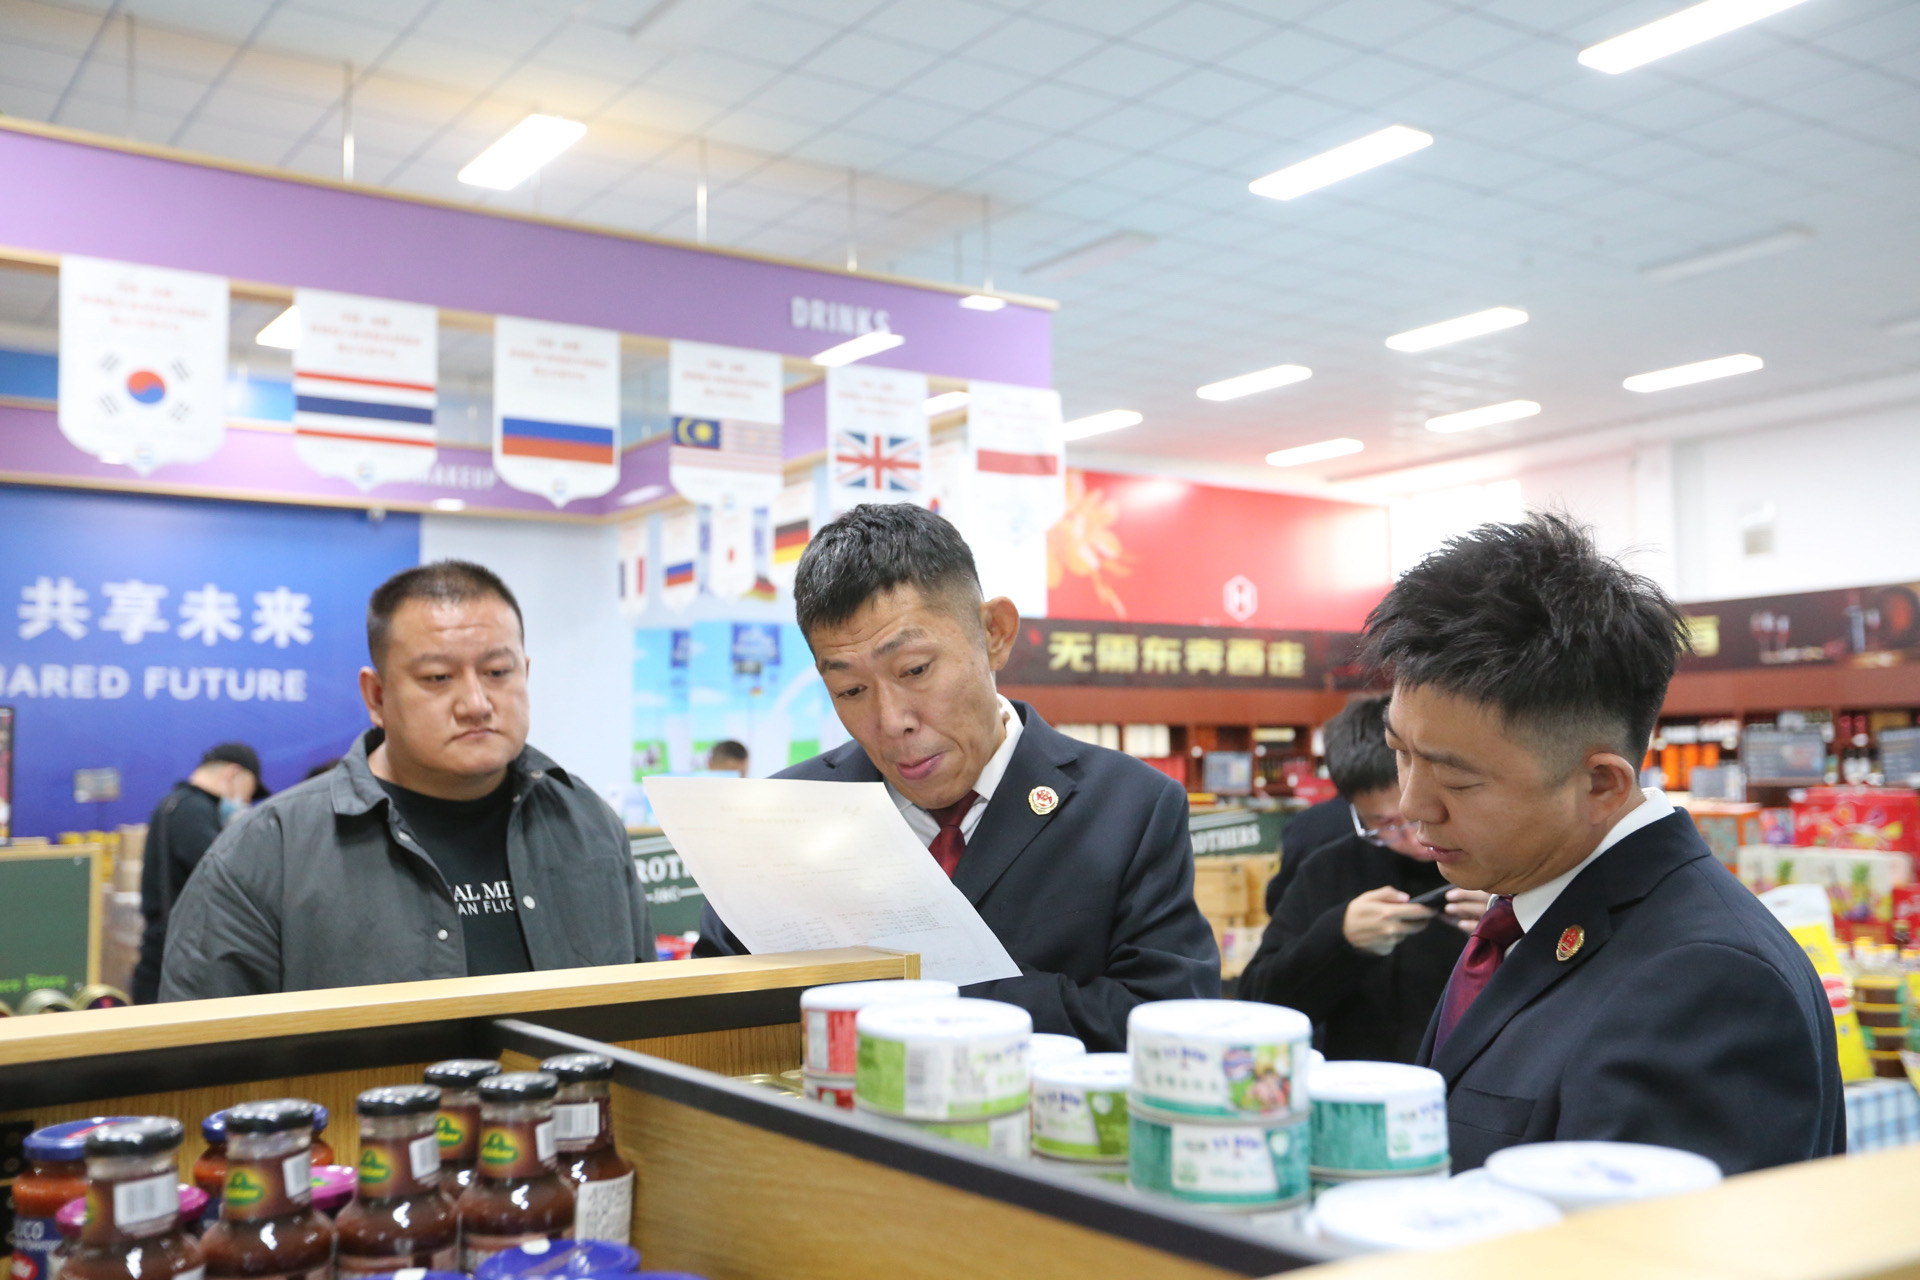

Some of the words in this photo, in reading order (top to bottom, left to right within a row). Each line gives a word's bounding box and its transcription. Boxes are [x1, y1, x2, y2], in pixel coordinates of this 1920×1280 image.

[16, 575, 314, 650] 共享未来
[143, 665, 308, 702] FUTURE
